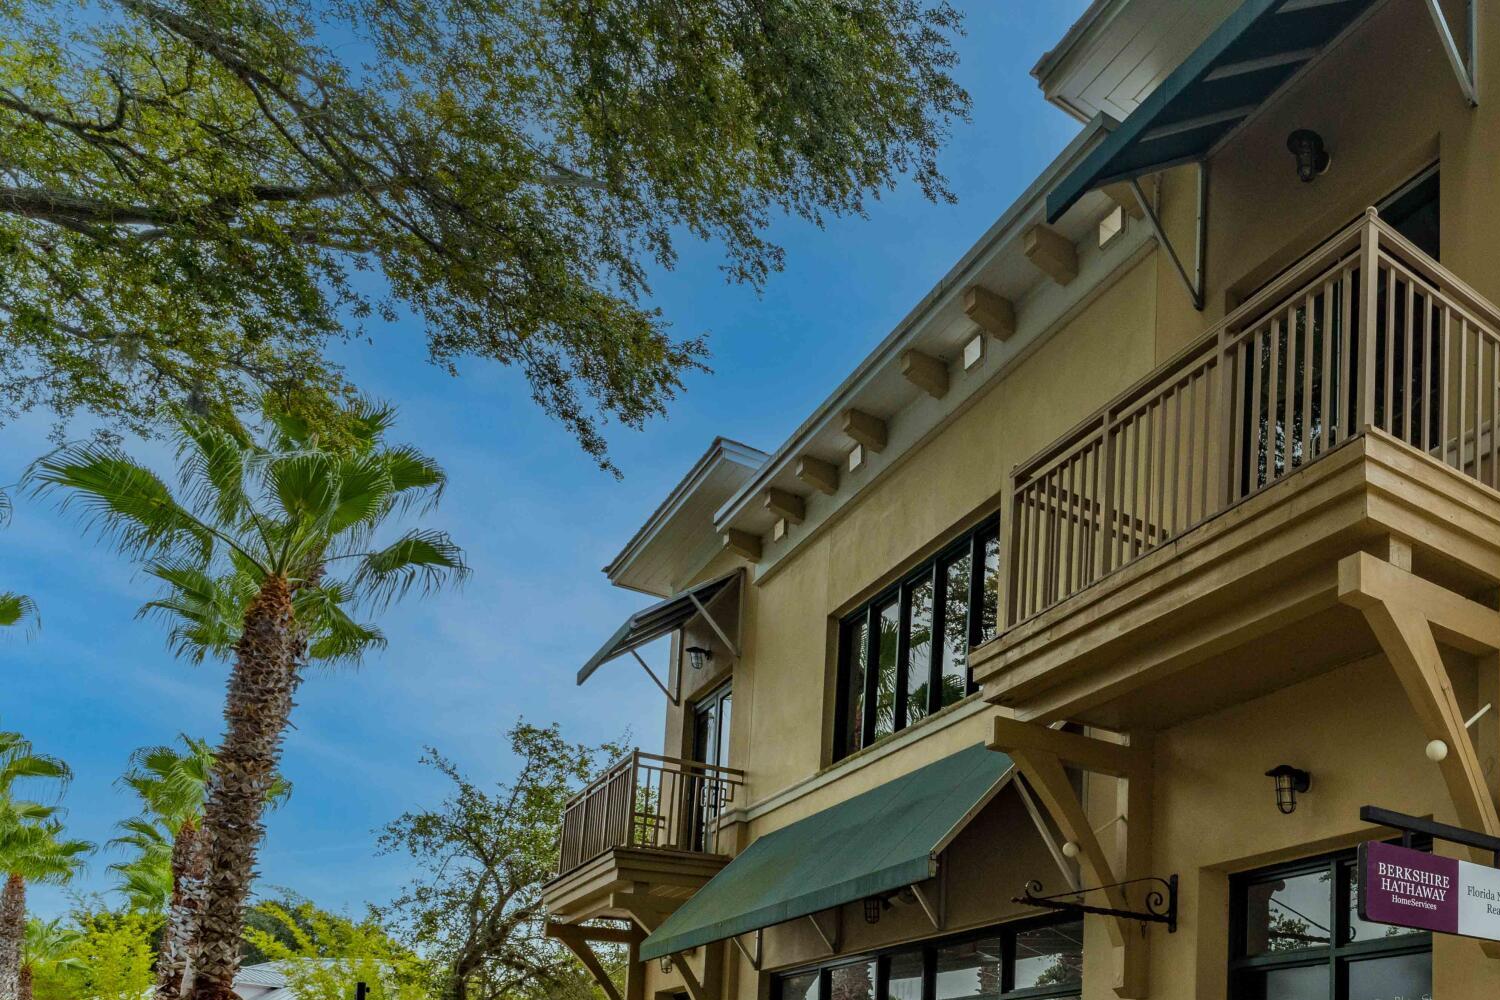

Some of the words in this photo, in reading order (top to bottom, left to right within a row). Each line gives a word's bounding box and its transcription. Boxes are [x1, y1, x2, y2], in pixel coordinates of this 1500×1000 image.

[1378, 863, 1450, 889] BERKSHIRE
[1381, 878, 1447, 902] HATHAWAY
[1467, 885, 1495, 901] Florida
[1391, 894, 1437, 911] HomeServices
